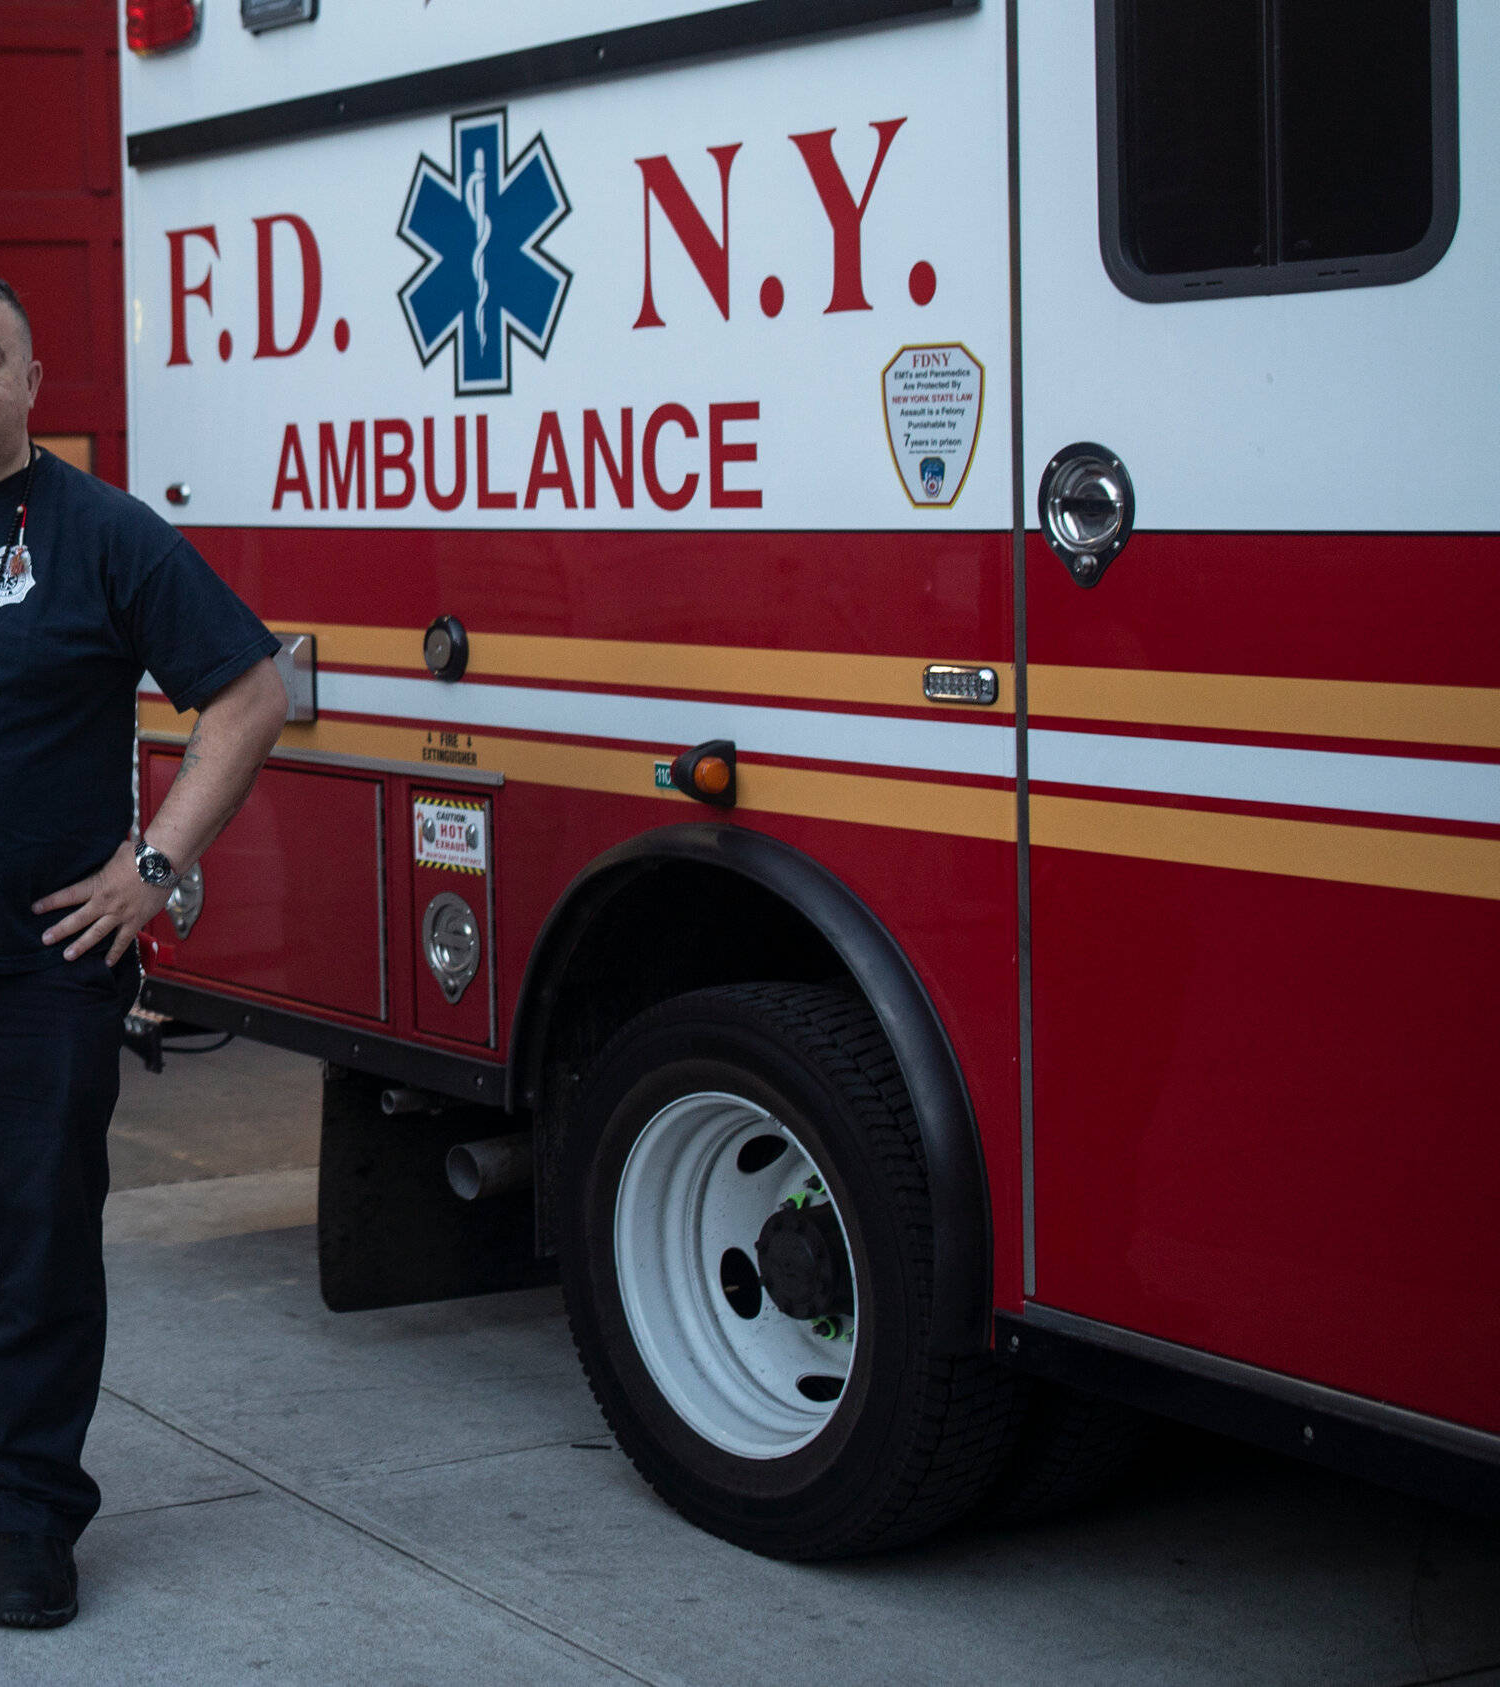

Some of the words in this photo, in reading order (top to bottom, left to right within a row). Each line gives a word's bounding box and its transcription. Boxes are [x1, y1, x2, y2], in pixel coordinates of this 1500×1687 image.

[166, 214, 350, 367] F.D.
[632, 117, 937, 330] N.Y.
[913, 352, 951, 368] FDNY
[915, 369, 928, 379] and
[929, 368, 970, 377] Paramedics
[903, 382, 915, 391] Are
[917, 381, 949, 390] Protected
[952, 380, 961, 390] By
[892, 395, 909, 404] NEW
[910, 394, 930, 403] YORK
[931, 393, 953, 403] STATE
[956, 393, 972, 402] LAW
[900, 408, 926, 417] Assault
[927, 408, 934, 416] is
[941, 407, 965, 416] Felony
[908, 420, 946, 429] Punishable
[948, 421, 956, 430] by
[904, 433, 911, 447] 7
[911, 440, 929, 448] years
[931, 437, 937, 446] in
[939, 438, 961, 448] prison
[272, 401, 763, 511] AMBULANCE
[441, 732, 458, 748] FIRE
[422, 747, 477, 766] EXTINGUISHER
[440, 824, 463, 839] HOT
[436, 840, 469, 853] EXHAUST
